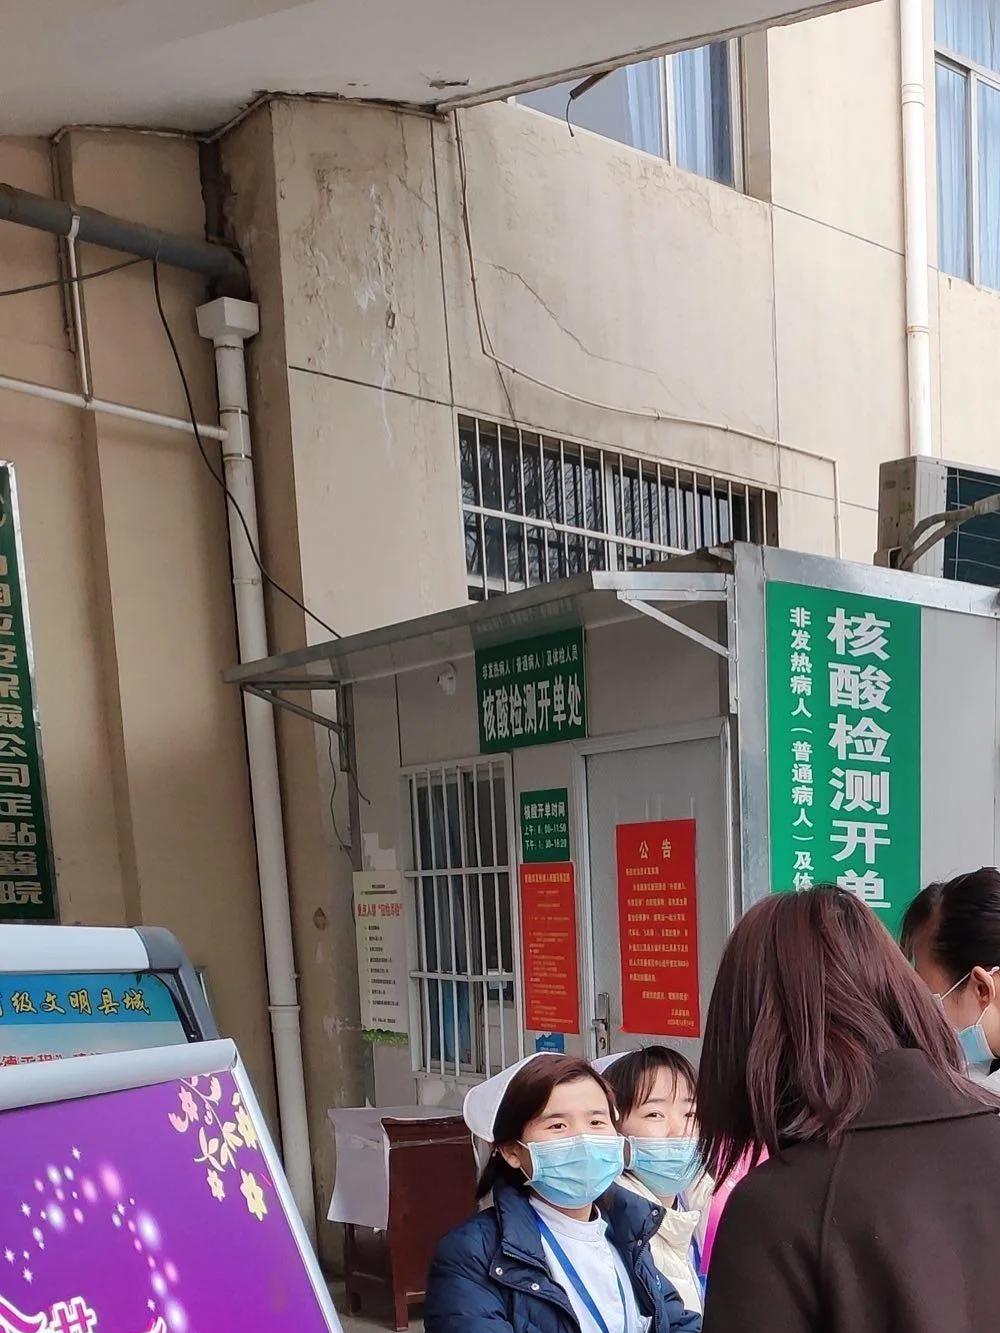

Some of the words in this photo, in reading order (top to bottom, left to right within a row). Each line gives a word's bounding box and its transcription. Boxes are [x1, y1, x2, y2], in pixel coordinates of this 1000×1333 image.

[482, 672, 583, 742] 核酸检测开单处
[0, 988, 151, 1016] 级文明县城
